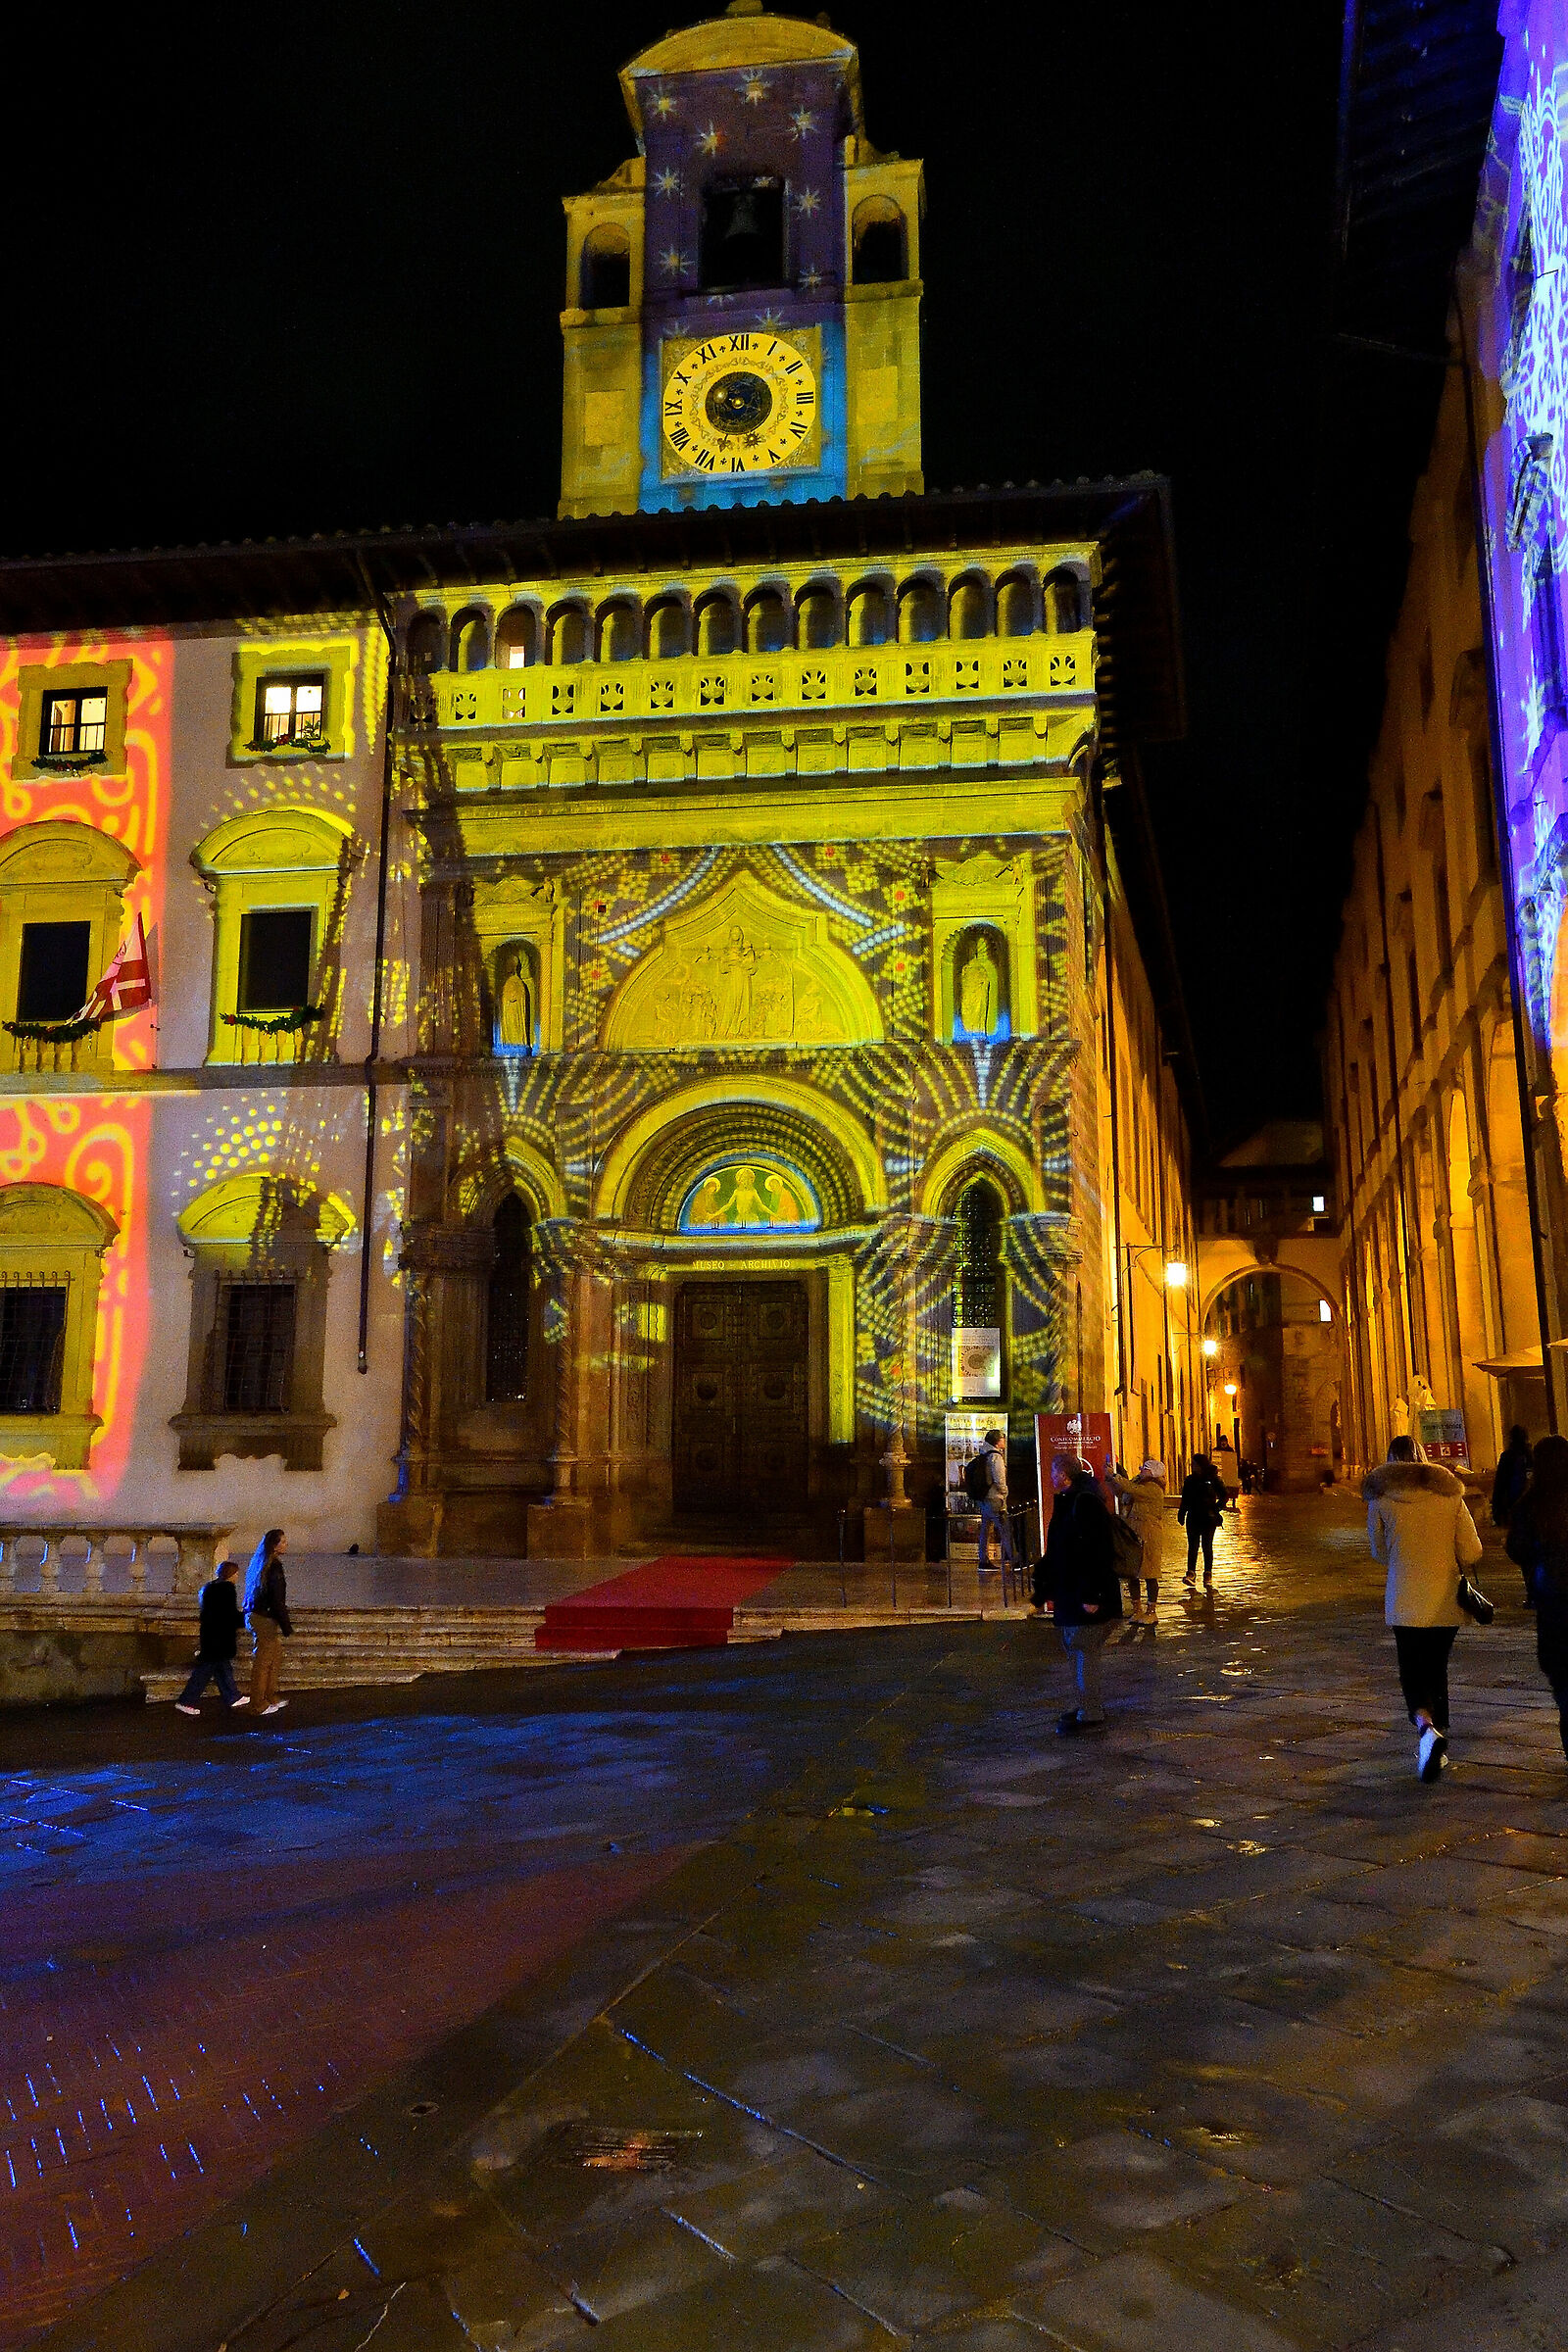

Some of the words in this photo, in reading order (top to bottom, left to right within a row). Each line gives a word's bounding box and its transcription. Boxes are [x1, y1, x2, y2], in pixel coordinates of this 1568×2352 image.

[729, 334, 750, 351] XII
[696, 344, 717, 365] XI
[785, 361, 804, 374] II
[673, 371, 692, 386] X
[796, 392, 814, 405] III
[664, 399, 683, 416] IX
[789, 421, 808, 439] IV
[669, 427, 692, 452] VIII
[694, 449, 715, 471] VII
[767, 449, 781, 464] V
[731, 458, 745, 472] VI
[692, 1260, 725, 1270] MUSEO
[741, 1259, 791, 1269] ARCHIVIO
